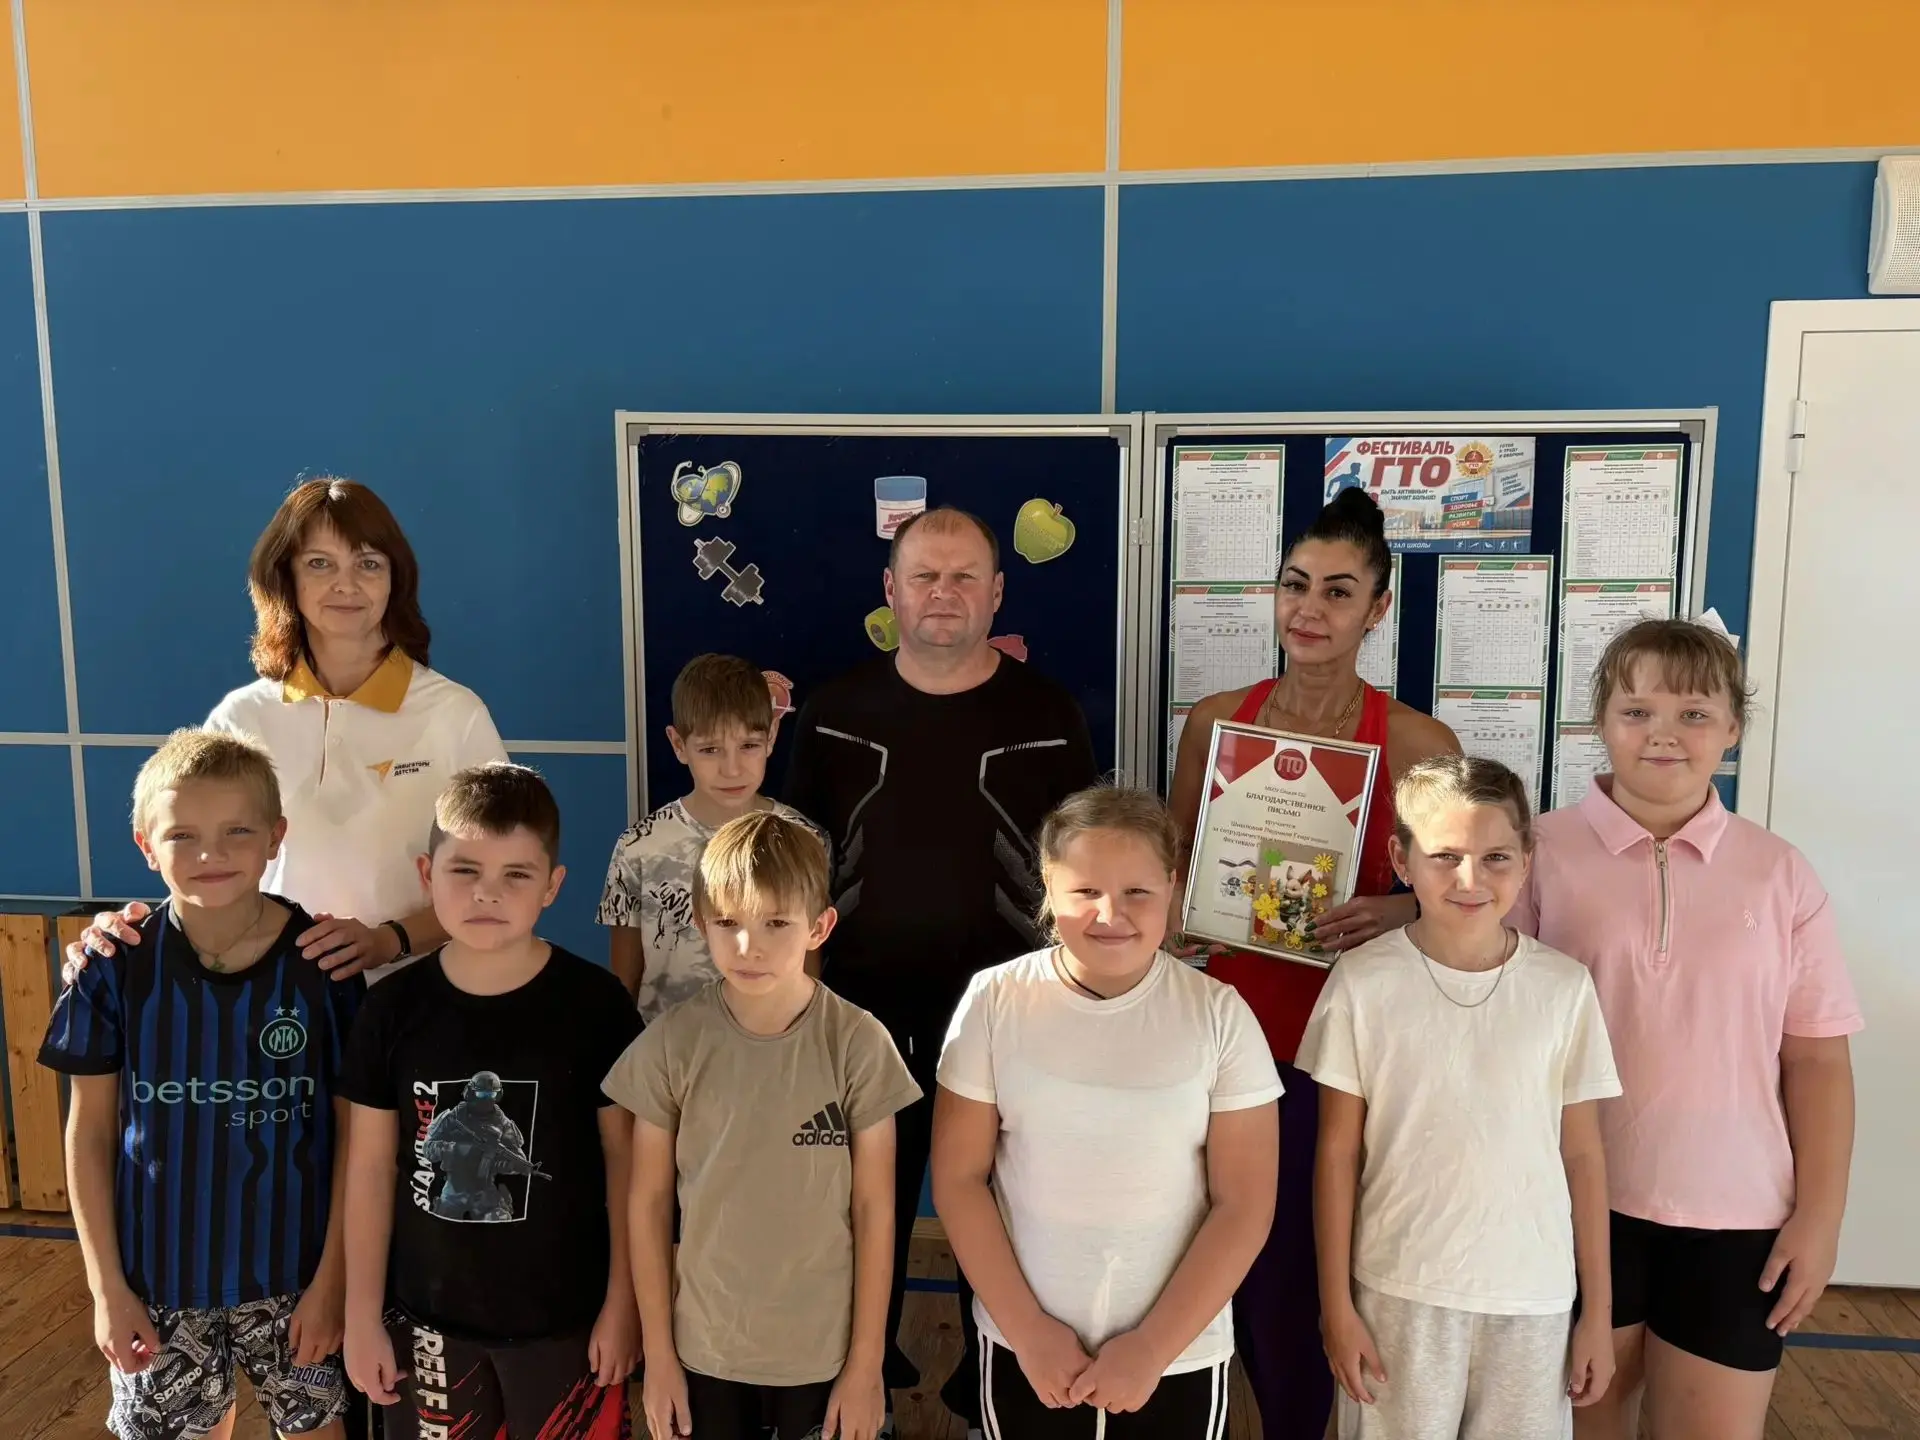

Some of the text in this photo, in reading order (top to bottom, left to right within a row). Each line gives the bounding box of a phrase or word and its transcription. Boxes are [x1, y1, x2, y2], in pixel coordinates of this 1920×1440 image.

[1356, 440, 1455, 456] ФЕСТИВАЛЬ
[1369, 456, 1452, 488] ГТО
[1450, 494, 1469, 502] СПОРТ
[1246, 791, 1327, 813] БЛАГОДАРСТВЕННОЕ
[1267, 806, 1301, 817] ПИСЬМО
[131, 1071, 315, 1104] betsson
[224, 1101, 312, 1130] .sport
[153, 1366, 203, 1404] adidas
